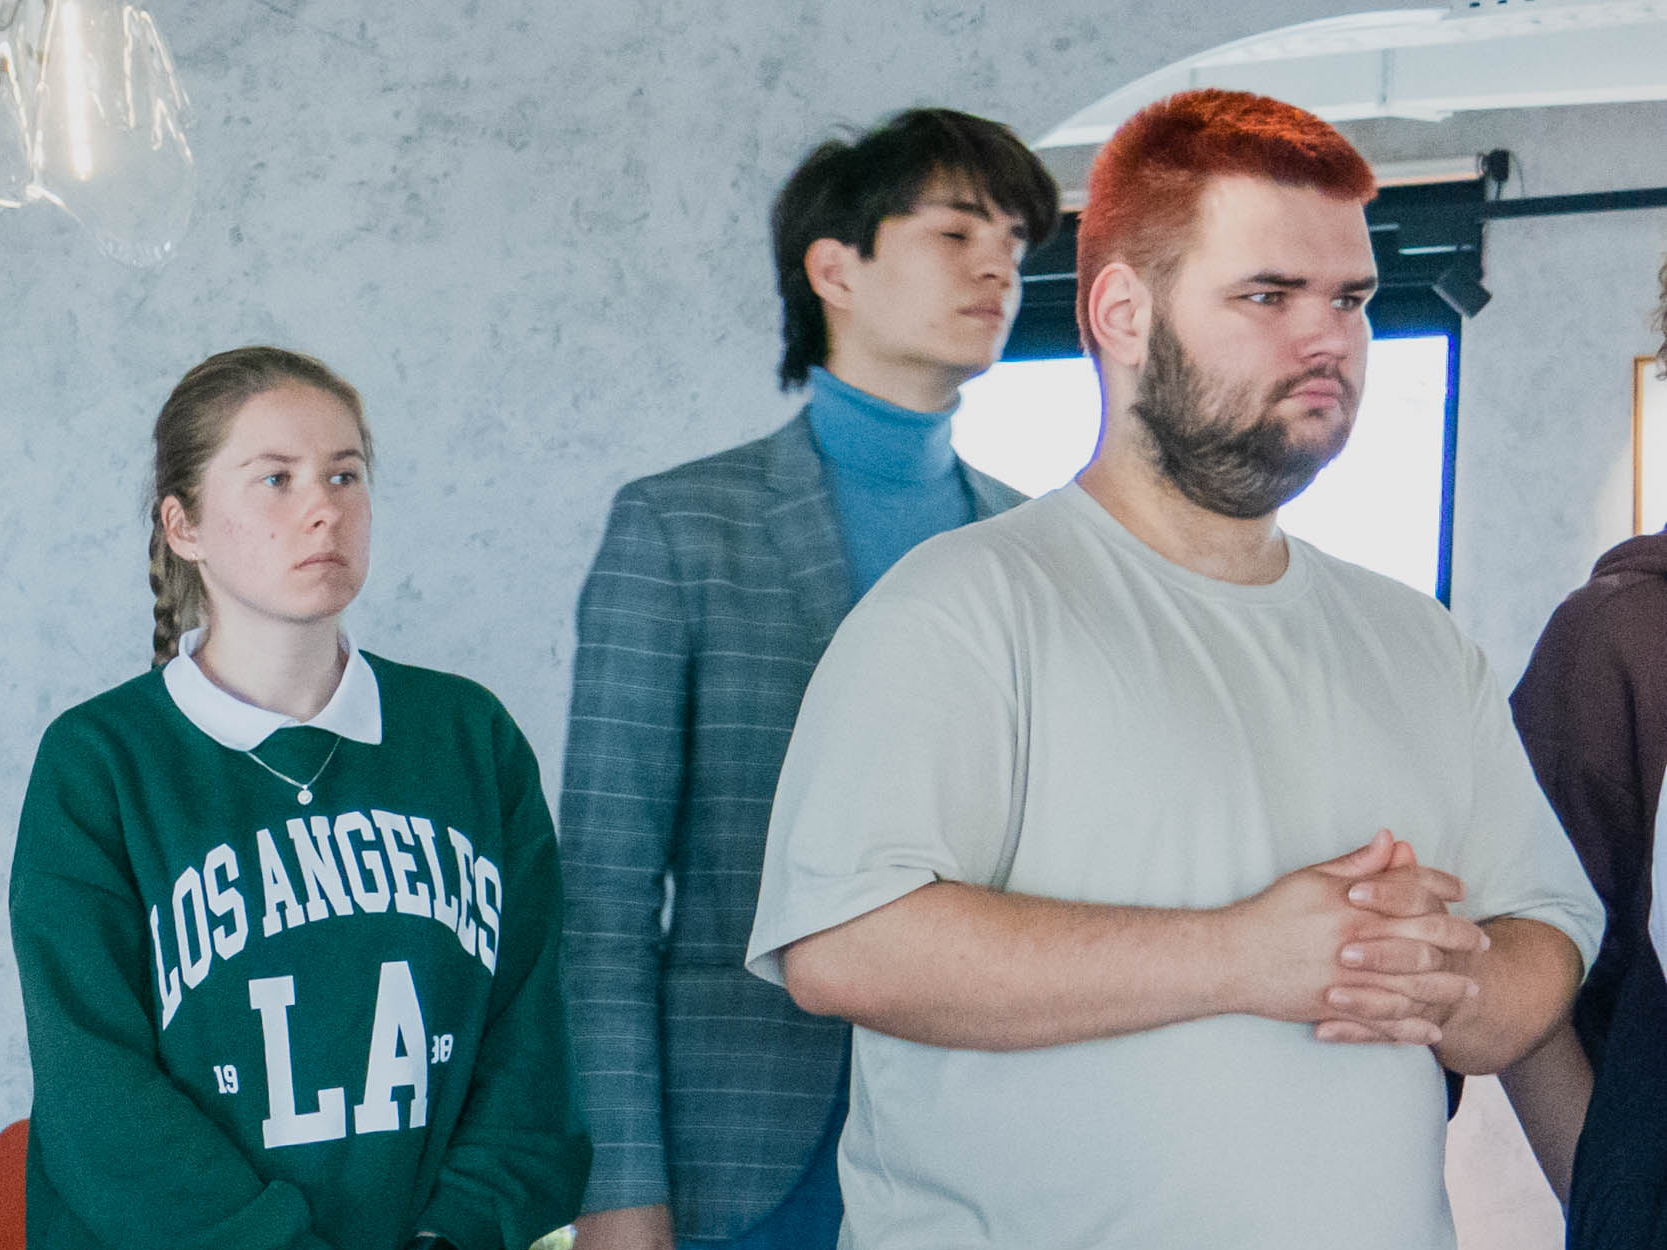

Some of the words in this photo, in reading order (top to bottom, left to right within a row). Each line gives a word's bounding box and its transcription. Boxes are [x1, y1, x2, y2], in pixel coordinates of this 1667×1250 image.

[150, 843, 249, 1031] LOS
[256, 809, 502, 977] ANGELES
[213, 1064, 239, 1094] 19
[248, 961, 429, 1149] LA
[430, 1033, 454, 1065] 38
